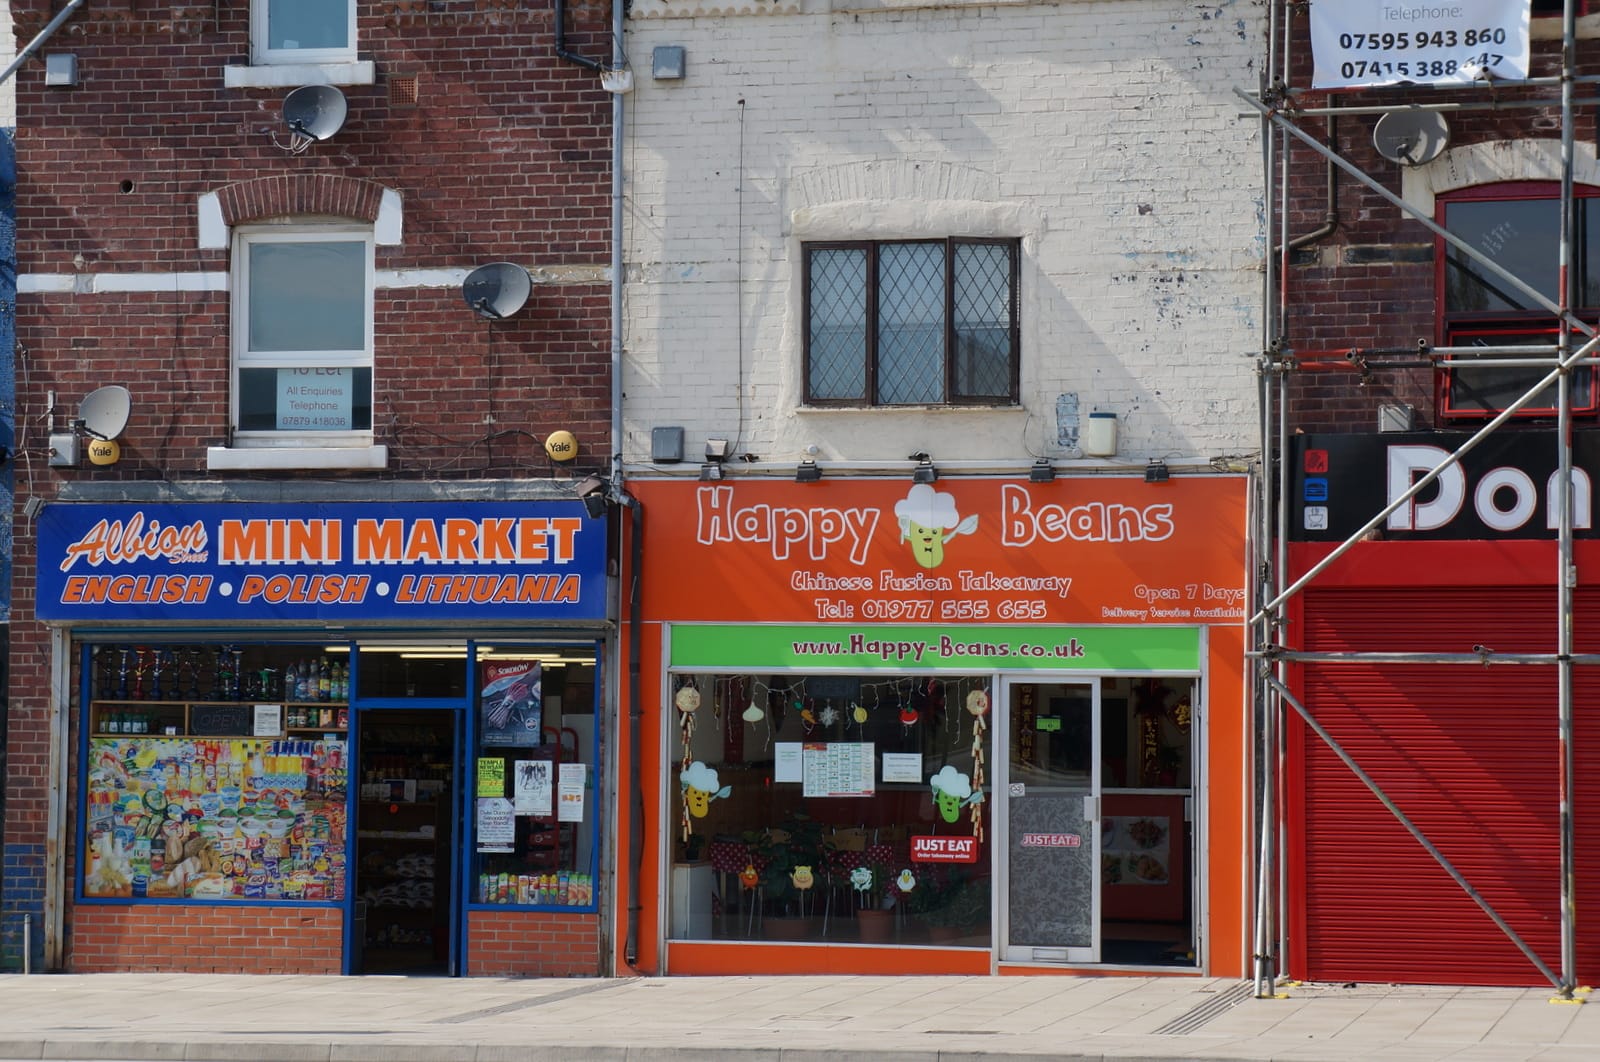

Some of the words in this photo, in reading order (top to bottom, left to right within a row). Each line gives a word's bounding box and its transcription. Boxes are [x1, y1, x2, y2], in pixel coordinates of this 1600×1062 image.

[1384, 6, 1463, 22] Telephone:
[1340, 32, 1409, 50] 07595
[1415, 30, 1458, 48] 943
[1464, 28, 1506, 47] 860
[1341, 61, 1409, 79] 07415
[1416, 60, 1457, 77] 388
[286, 386, 298, 395] All
[301, 386, 343, 397] Enquiries
[289, 401, 338, 411] Telephone
[282, 416, 310, 426] 07879
[312, 416, 346, 426] 418036
[92, 447, 112, 456] Yale
[551, 442, 570, 452] Yale
[1387, 445, 1592, 531] Don
[696, 486, 880, 565] Happy
[1001, 484, 1175, 547] Beans
[60, 511, 208, 572] Albion
[218, 519, 343, 565] MINI
[353, 517, 582, 565] MARKET
[60, 575, 214, 604] ENGLISH
[237, 574, 371, 604] POLISH
[394, 574, 581, 604] LITHUANIA
[791, 571, 873, 591] Chinese
[879, 570, 952, 591] Fusion
[959, 570, 1072, 598] Takeaway
[1134, 584, 1181, 604] Open
[1185, 584, 1198, 600] 7
[1203, 583, 1245, 605] Days
[814, 599, 854, 619] Tel:
[861, 600, 934, 619] 01977
[941, 600, 990, 619] 555
[996, 600, 1047, 619] 655
[792, 634, 1085, 661] www.Happy-Beans.co.uk
[914, 839, 946, 851] JUST
[948, 840, 973, 852] EAT
[1023, 835, 1049, 845] JUST
[1051, 835, 1072, 845] EAT
